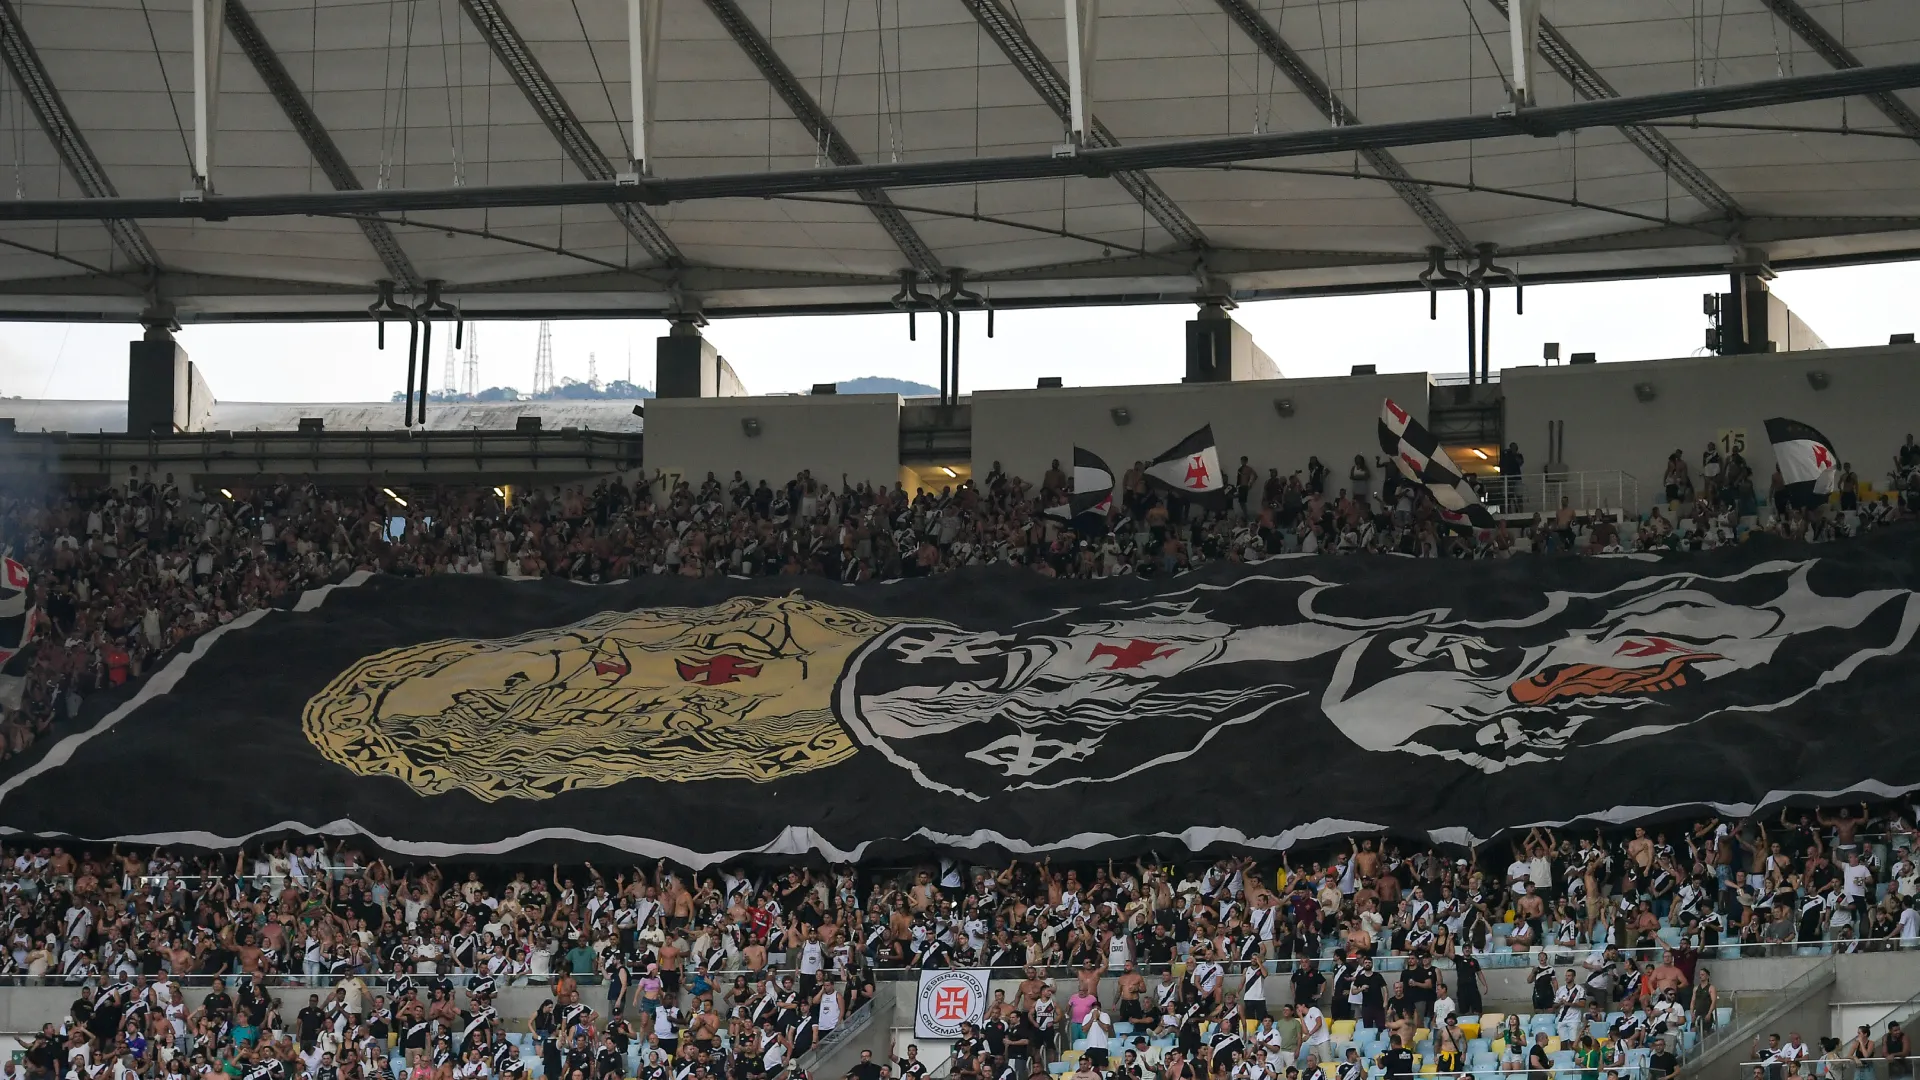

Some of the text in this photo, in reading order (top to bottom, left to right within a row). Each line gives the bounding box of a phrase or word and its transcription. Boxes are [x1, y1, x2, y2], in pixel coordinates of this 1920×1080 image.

[1721, 433, 1745, 453] 15
[659, 473, 681, 492] 17
[922, 973, 983, 999] DESBRAVADOR
[922, 1013, 979, 1035] CRUZMALO
